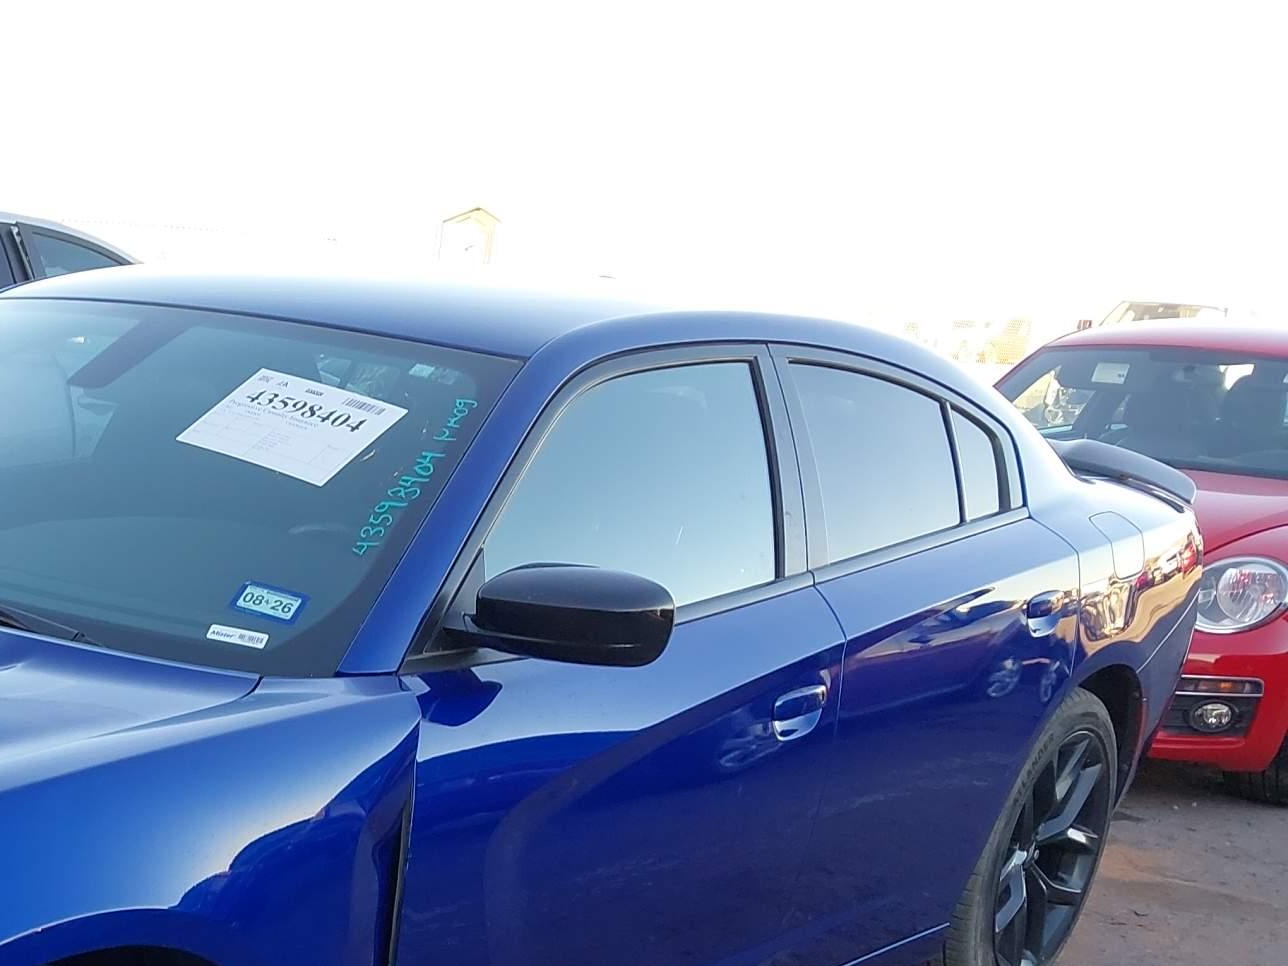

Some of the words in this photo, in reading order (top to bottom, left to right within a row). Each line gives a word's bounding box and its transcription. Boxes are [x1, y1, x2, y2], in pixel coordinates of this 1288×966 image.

[246, 389, 368, 433] 43598404
[242, 591, 265, 606] 08
[269, 599, 294, 614] 26
